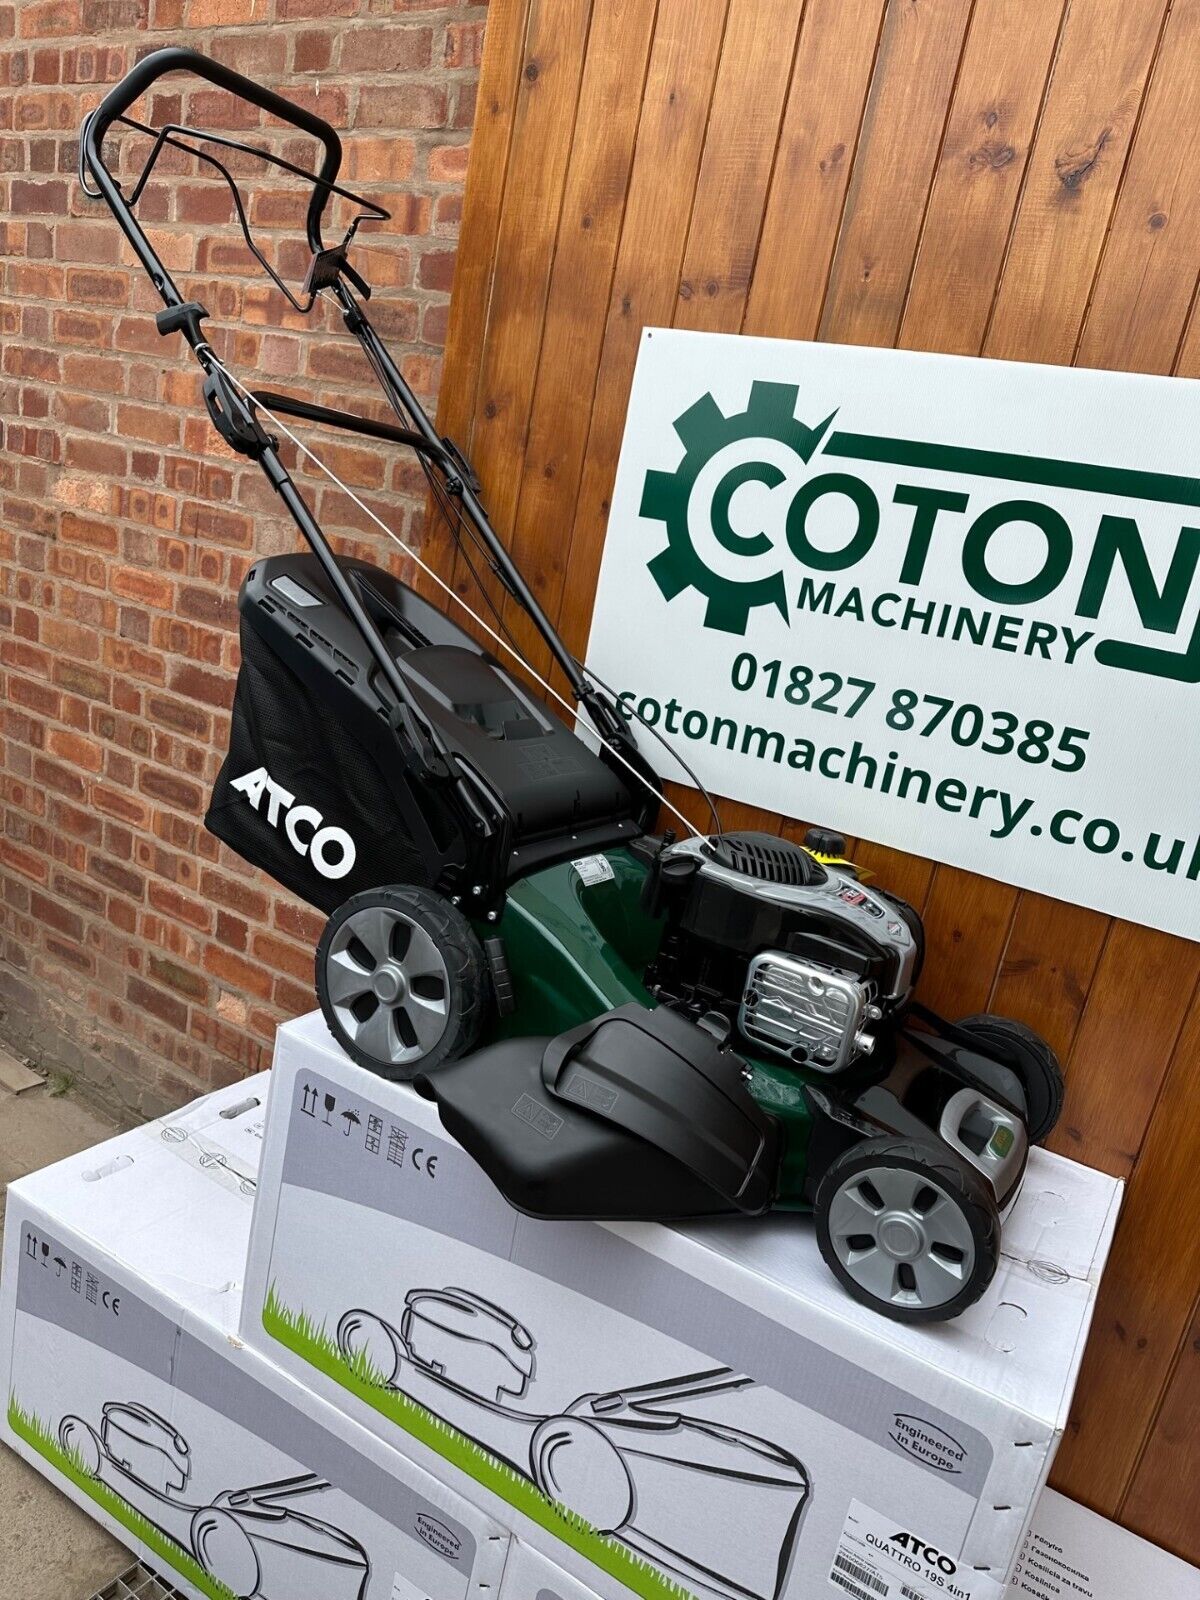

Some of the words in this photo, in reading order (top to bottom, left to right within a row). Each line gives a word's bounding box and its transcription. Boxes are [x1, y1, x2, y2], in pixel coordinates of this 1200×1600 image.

[710, 461, 1200, 634] COTON
[797, 577, 1095, 664] MACHINERY
[730, 652, 876, 717] 01827
[885, 689, 1091, 773] 870385
[229, 766, 357, 880] ATCO
[894, 1417, 964, 1462] Engineered
[896, 1432, 909, 1445] in
[911, 1441, 954, 1470] Europe
[417, 1516, 460, 1551] Engineered
[419, 1527, 427, 1537] in
[428, 1533, 455, 1556] Europe
[889, 1532, 957, 1575] ATCO
[865, 1533, 922, 1573] QUATTRO
[925, 1569, 945, 1587] 19S
[947, 1583, 971, 1600] 4in1
[1061, 1577, 1071, 1586] za
[1072, 1582, 1093, 1598] travu
